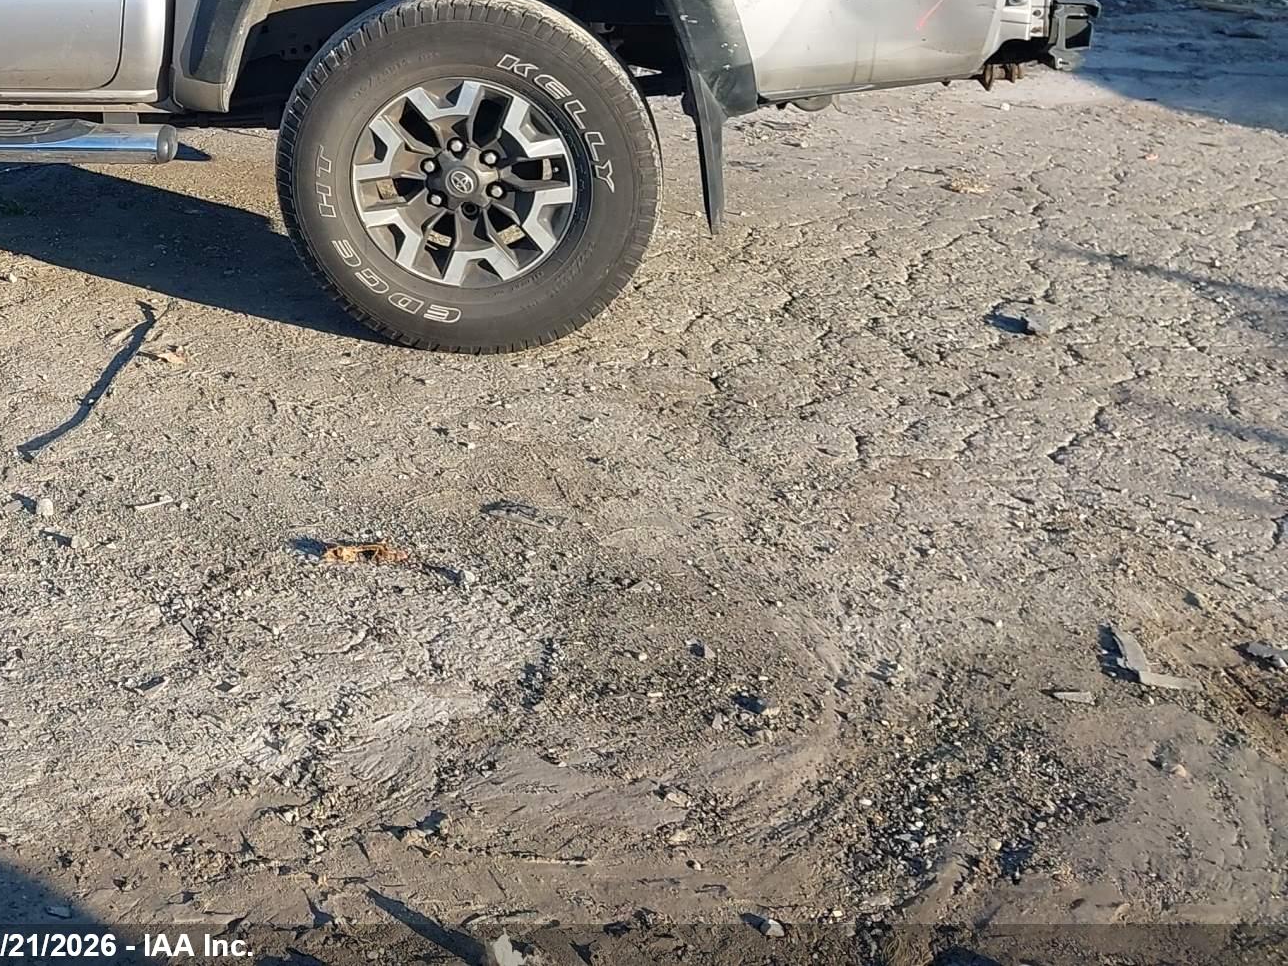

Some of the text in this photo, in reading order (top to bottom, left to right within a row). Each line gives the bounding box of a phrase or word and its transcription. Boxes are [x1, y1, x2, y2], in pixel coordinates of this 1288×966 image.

[496, 54, 616, 193] KELLY
[316, 145, 462, 324] EDGE HT
